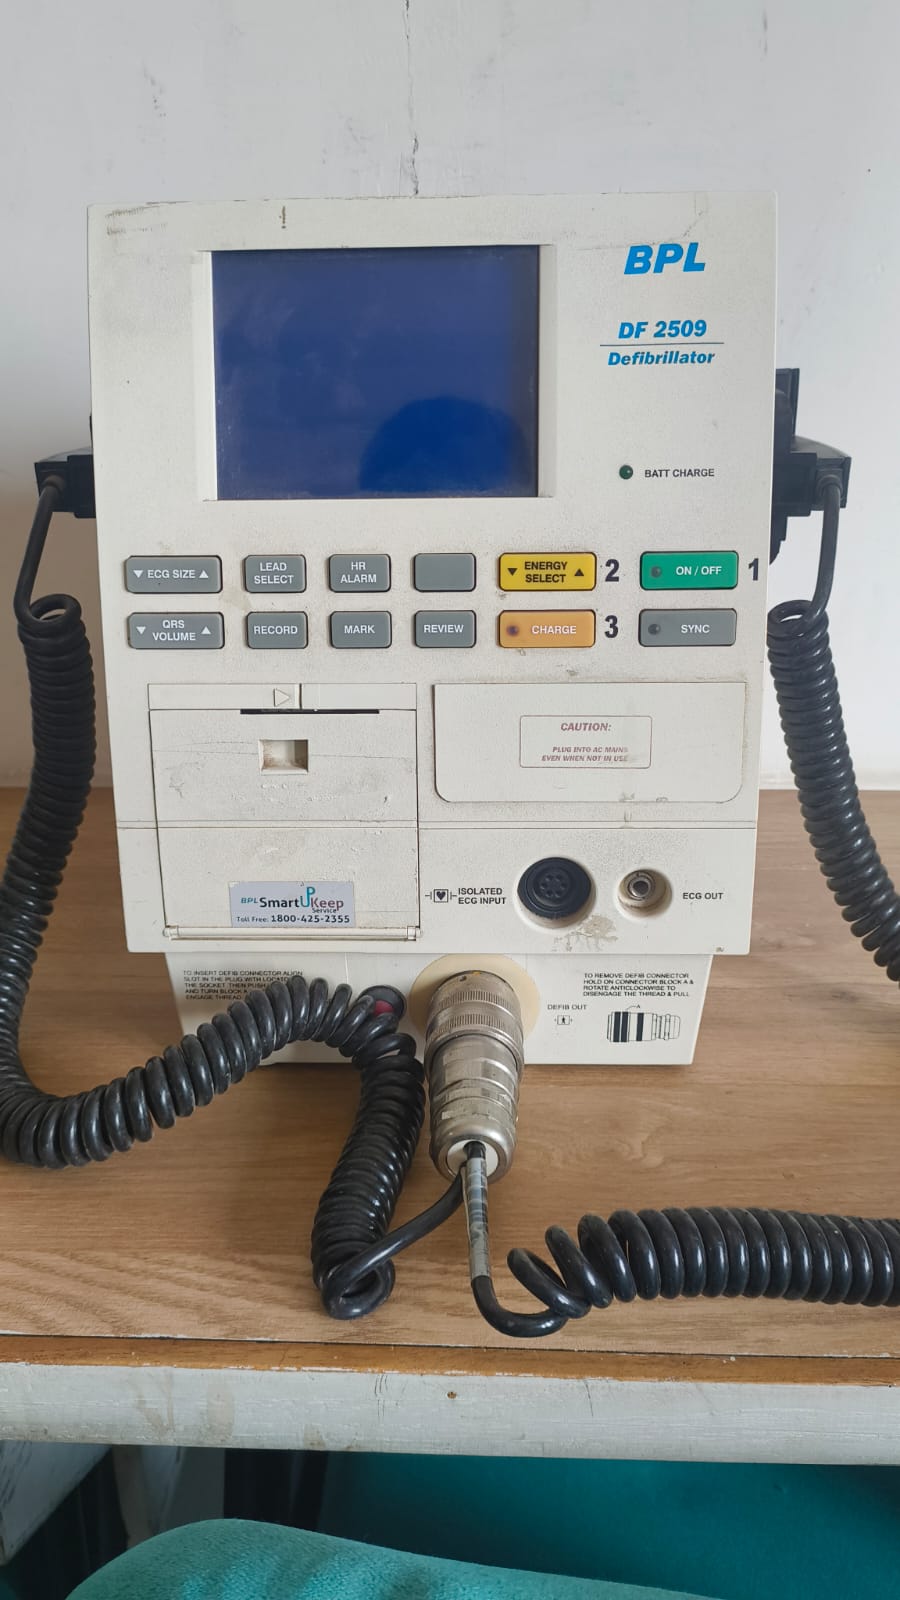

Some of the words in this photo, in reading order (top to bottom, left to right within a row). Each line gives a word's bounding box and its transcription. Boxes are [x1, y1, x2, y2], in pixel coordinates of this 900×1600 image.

[624, 242, 706, 275] BPL
[618, 321, 648, 339] DF
[653, 319, 707, 338] 2509
[607, 350, 715, 366] Defibrillator
[644, 468, 670, 478] BATT
[672, 467, 715, 478] CHARGE
[259, 561, 288, 572] LEAD
[350, 561, 366, 571] HR
[524, 560, 568, 572] ENERGY
[604, 558, 620, 582] 2
[675, 565, 693, 576] ON
[701, 565, 723, 576] OFF
[748, 558, 760, 581] 1
[147, 569, 170, 579] ECG
[172, 569, 196, 579] SIZE
[253, 574, 295, 585] SELECT
[340, 574, 377, 584] ALARM
[525, 573, 567, 584] SELECT
[162, 619, 186, 630] QRS
[344, 623, 376, 635] MARK
[423, 624, 465, 635] REVIEW
[531, 624, 578, 636] CHARGE
[604, 615, 619, 639] 3
[680, 624, 711, 636] SYNC
[253, 625, 299, 636] RECORD
[152, 631, 197, 642] VOLUME
[560, 722, 612, 731] CAUTION:
[458, 887, 503, 896] ISOLATED
[682, 892, 702, 901] ECG
[704, 892, 724, 901] OUT
[458, 897, 478, 905] ECG
[479, 897, 507, 905] INPUT
[271, 914, 350, 923] 1800-425-2355
